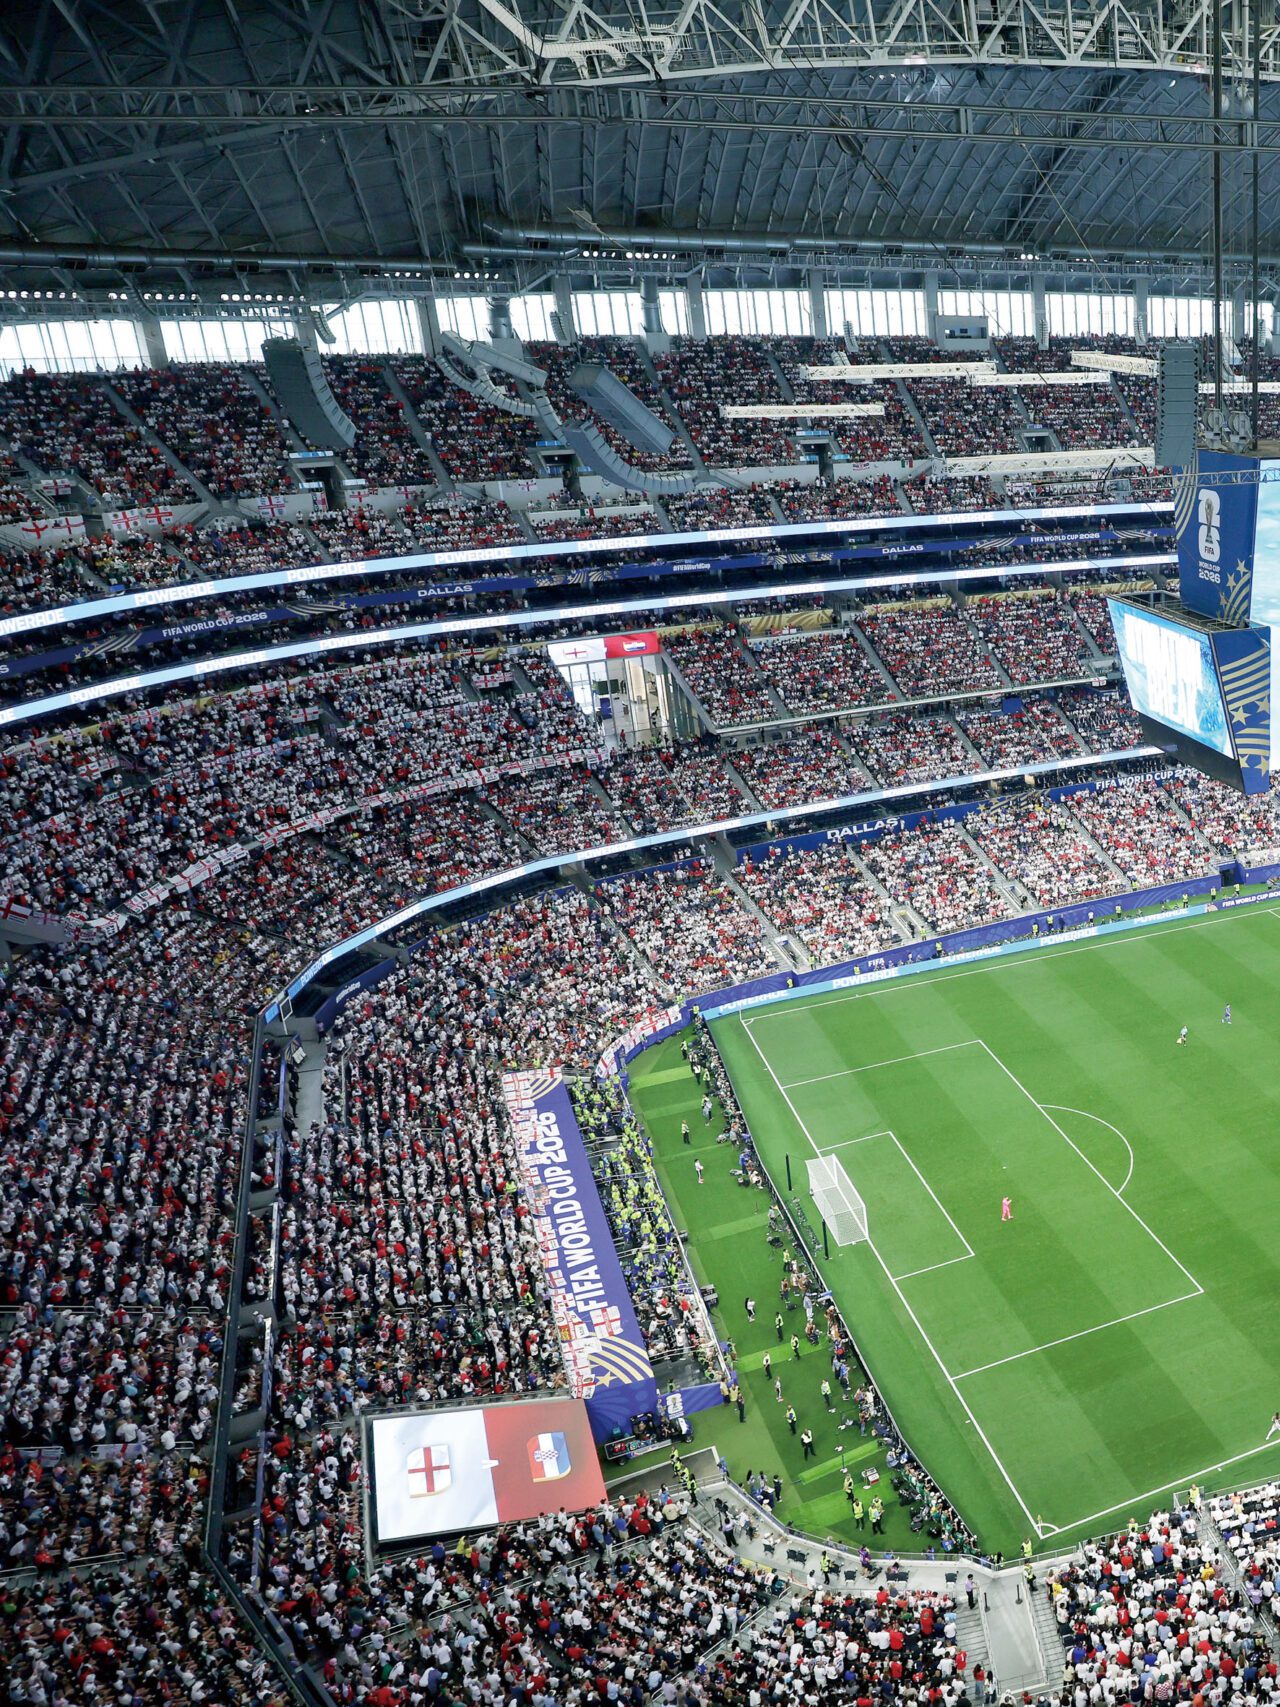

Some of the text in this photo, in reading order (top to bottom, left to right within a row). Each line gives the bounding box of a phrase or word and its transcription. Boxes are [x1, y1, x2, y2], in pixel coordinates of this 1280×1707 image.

[707, 527, 772, 541] POWERADE
[826, 519, 887, 532] POWERADE
[577, 536, 648, 552] POWERADE
[1079, 532, 1100, 540] 2026
[434, 547, 512, 564] POWERADE
[882, 546, 924, 555] DALLAS
[1204, 545, 1215, 556] FIFA
[287, 562, 366, 583] POWERADE
[1198, 560, 1221, 572] WORLD CUP
[1198, 568, 1221, 584] 2026
[135, 582, 215, 607] POWERADE
[417, 585, 473, 597] DALLAS
[560, 603, 623, 619] POWERADE
[162, 612, 268, 637] FIFA WORLD CUP 2026
[442, 615, 510, 632] POWERADE
[319, 630, 390, 650] POWERADE
[195, 650, 267, 674] POWERADE
[70, 676, 141, 704] POWERADE
[1096, 780, 1117, 790] FIFA
[1154, 770, 1173, 781] CUP
[826, 817, 898, 840] DALLAS
[1222, 900, 1235, 908] FIFA
[1236, 896, 1256, 905] WORLD
[1256, 893, 1269, 901] CUP
[1040, 927, 1098, 946] POWERADE
[868, 957, 885, 967] FIFA
[940, 945, 1002, 965] POWERADE
[832, 967, 899, 989] POWERADE
[719, 990, 789, 1013] POWERADE
[535, 1111, 609, 1313] FIFA WORLD CUP 2026
